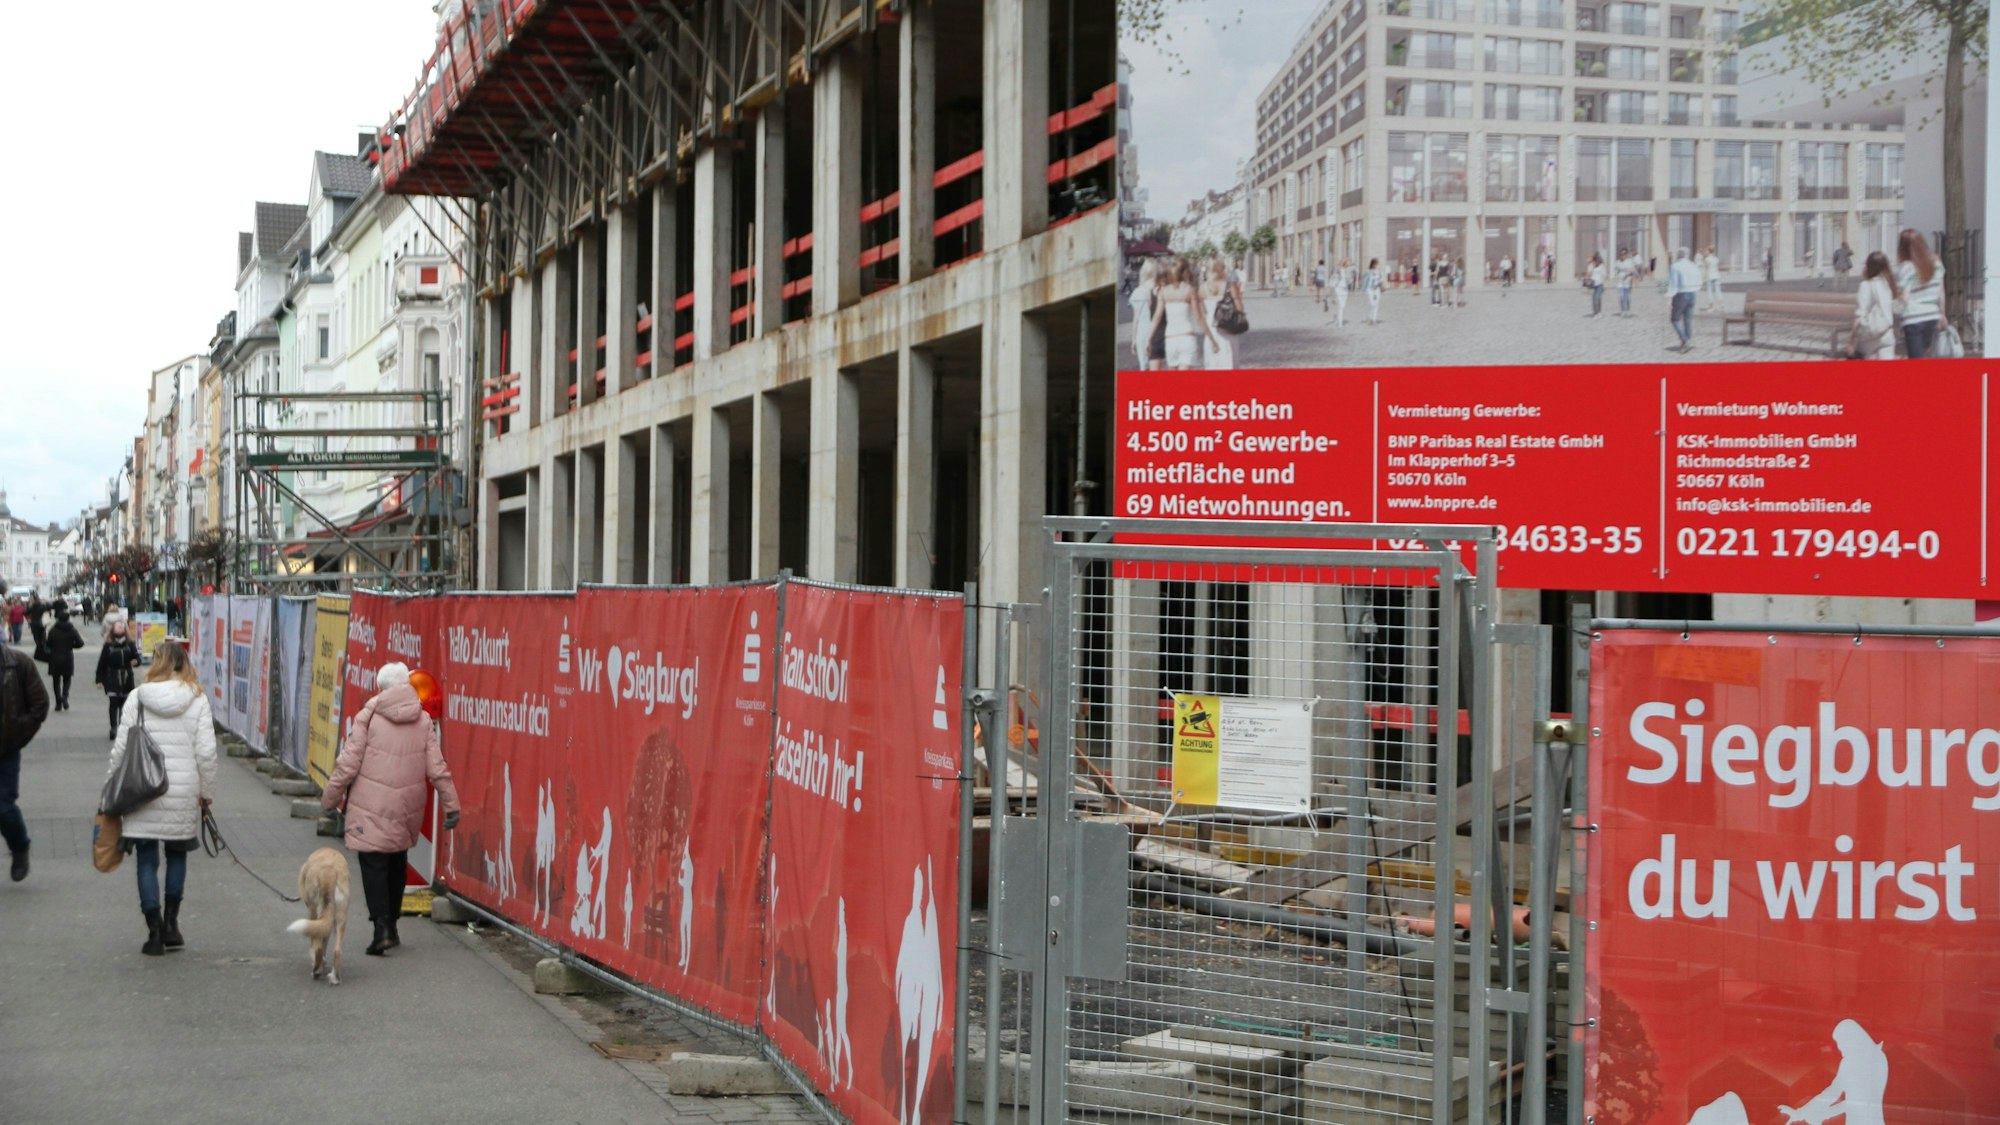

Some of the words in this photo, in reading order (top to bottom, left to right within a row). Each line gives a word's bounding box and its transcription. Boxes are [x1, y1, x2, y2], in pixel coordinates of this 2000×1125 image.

[1129, 399, 1174, 420] Hier
[1179, 398, 1292, 420] entstehen
[1388, 404, 1470, 420] Vermietung
[1473, 403, 1540, 417] Gewerbe:
[1677, 402, 1768, 419] Vermietung
[1771, 401, 1843, 415] Wohnen:
[1127, 432, 1188, 452] 4.500
[1194, 430, 1222, 452] m²
[1229, 430, 1338, 452] Gewerbe-
[1388, 435, 1417, 448] BNP
[1420, 435, 1472, 448] Paribas
[1476, 434, 1506, 448] Real
[1510, 435, 1555, 448] Estate
[1559, 434, 1603, 448] GmbH
[1677, 434, 1804, 448] KSK-Immobilien
[1807, 434, 1856, 448] GmbH
[288, 454, 304, 462] ALI
[1388, 454, 1405, 466] Im
[1409, 454, 1487, 468] Klapperhof
[1677, 454, 1796, 468] Richmodstraße
[1800, 454, 1810, 468] 2
[1128, 462, 1245, 484] mietfläche
[1252, 462, 1294, 484] und
[1388, 473, 1431, 485] 50670
[1434, 472, 1466, 486] Köln
[1677, 474, 1724, 487] 50667
[1728, 474, 1764, 488] Köln
[1127, 494, 1153, 514] 69
[1159, 494, 1351, 521] Mietwohnungen.
[1387, 495, 1497, 511] www.bnppre.de
[1677, 497, 1871, 515] info@ksk-immobilien.de
[1473, 525, 1643, 554] 34633-35
[1677, 528, 1759, 556] 0221
[1772, 529, 1939, 559] 179494-0
[622, 649, 700, 720] Siegburg!
[1180, 738, 1213, 749] ACHTUNG
[1628, 833, 1731, 919] du
[1756, 834, 1977, 922] wirst
